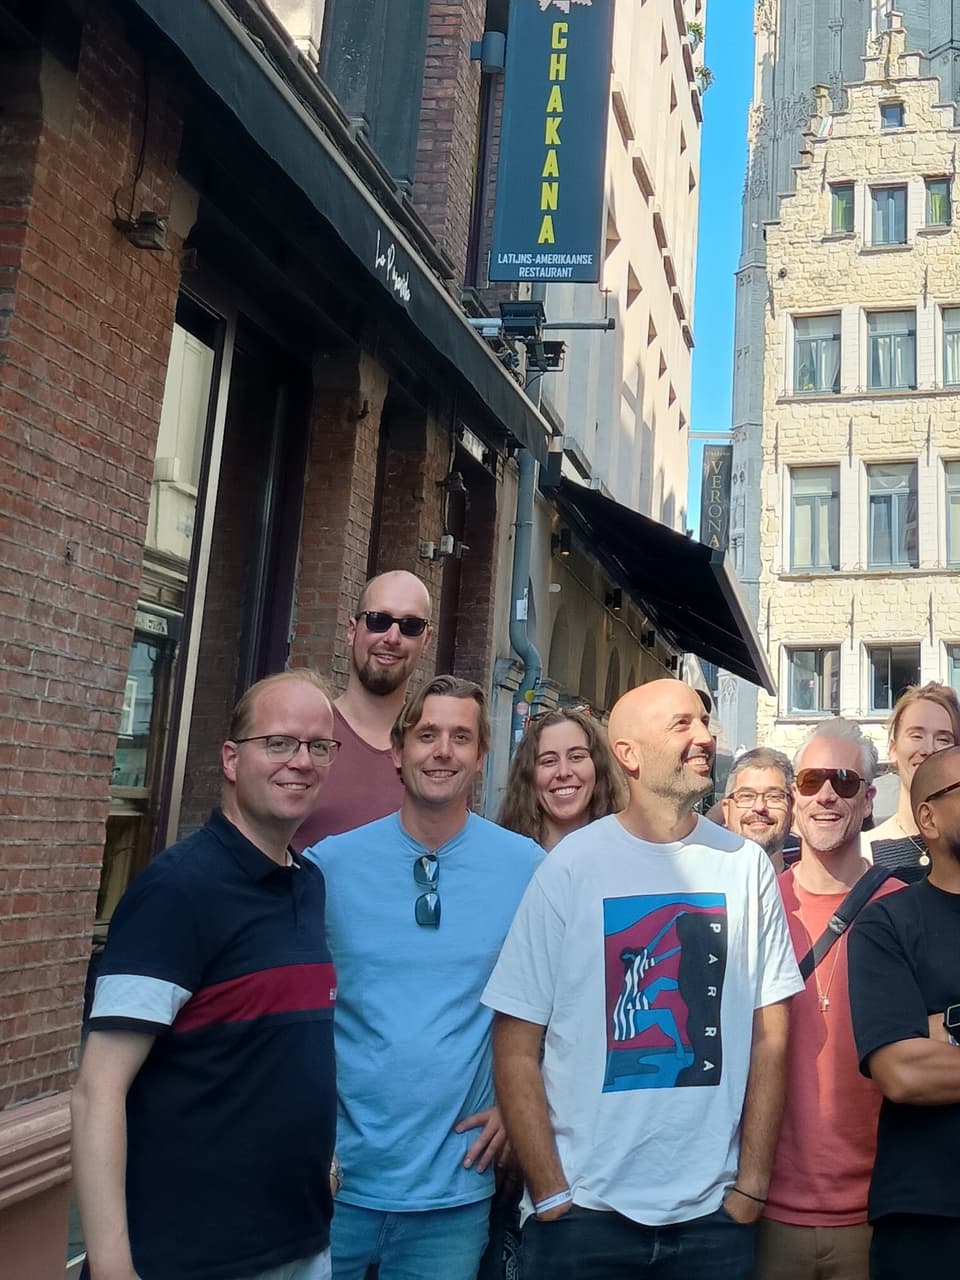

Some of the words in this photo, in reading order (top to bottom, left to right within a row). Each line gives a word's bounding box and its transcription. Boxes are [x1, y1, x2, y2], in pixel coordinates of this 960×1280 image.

[538, 22, 568, 243] CHAKANA
[498, 254, 592, 265] LATIJNS-AMERIKAANSE
[519, 267, 573, 277] RESTAURANT
[708, 461, 723, 548] VERONA
[703, 923, 721, 1071] PARRA
